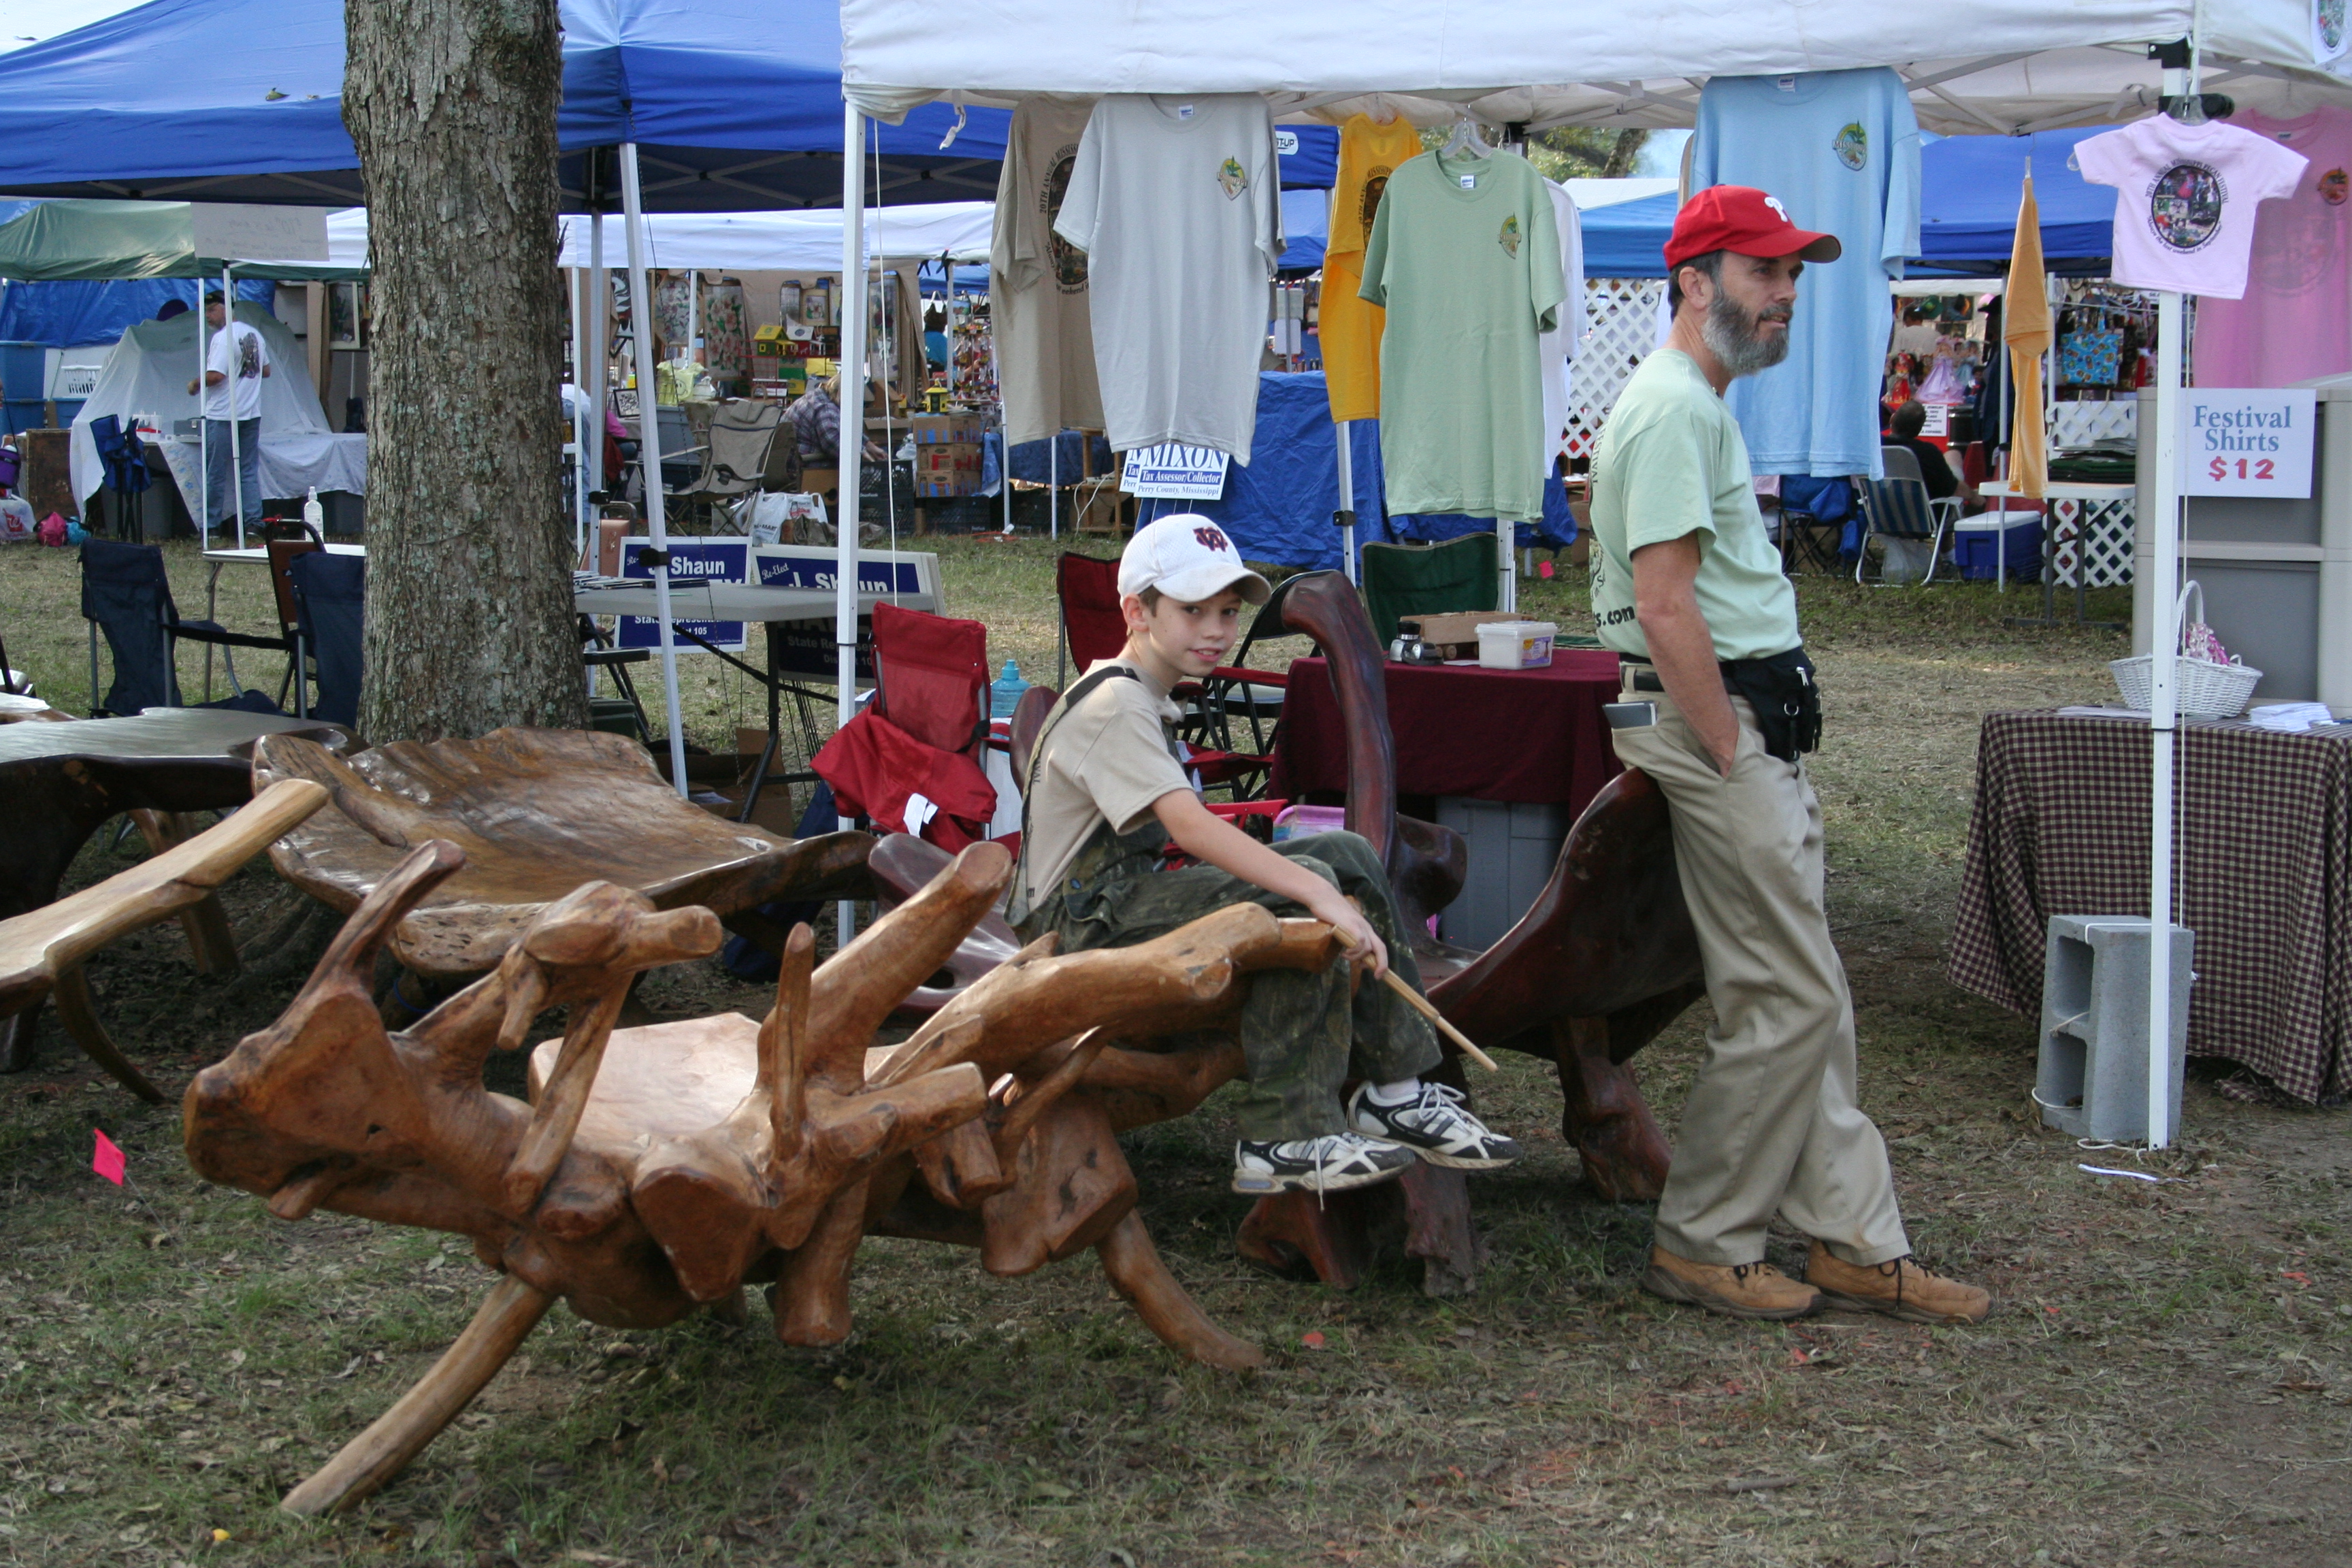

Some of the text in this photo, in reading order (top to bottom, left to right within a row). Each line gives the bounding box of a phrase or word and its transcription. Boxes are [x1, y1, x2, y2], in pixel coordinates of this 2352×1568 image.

[2193, 405, 2291, 428] Festival
[2204, 429, 2279, 452] Shirts
[1143, 444, 1226, 470] MIXON
[1141, 470, 1221, 484] Tax Assessor/Collector
[2208, 456, 2274, 482] $12
[1123, 479, 1137, 487] Perr
[1137, 485, 1220, 497] Perry County, Mississippi
[670, 556, 725, 575] Shaun
[762, 563, 789, 580] Re-Elect
[815, 572, 888, 592] Shun
[694, 627, 707, 635] 105
[787, 636, 817, 647] State
